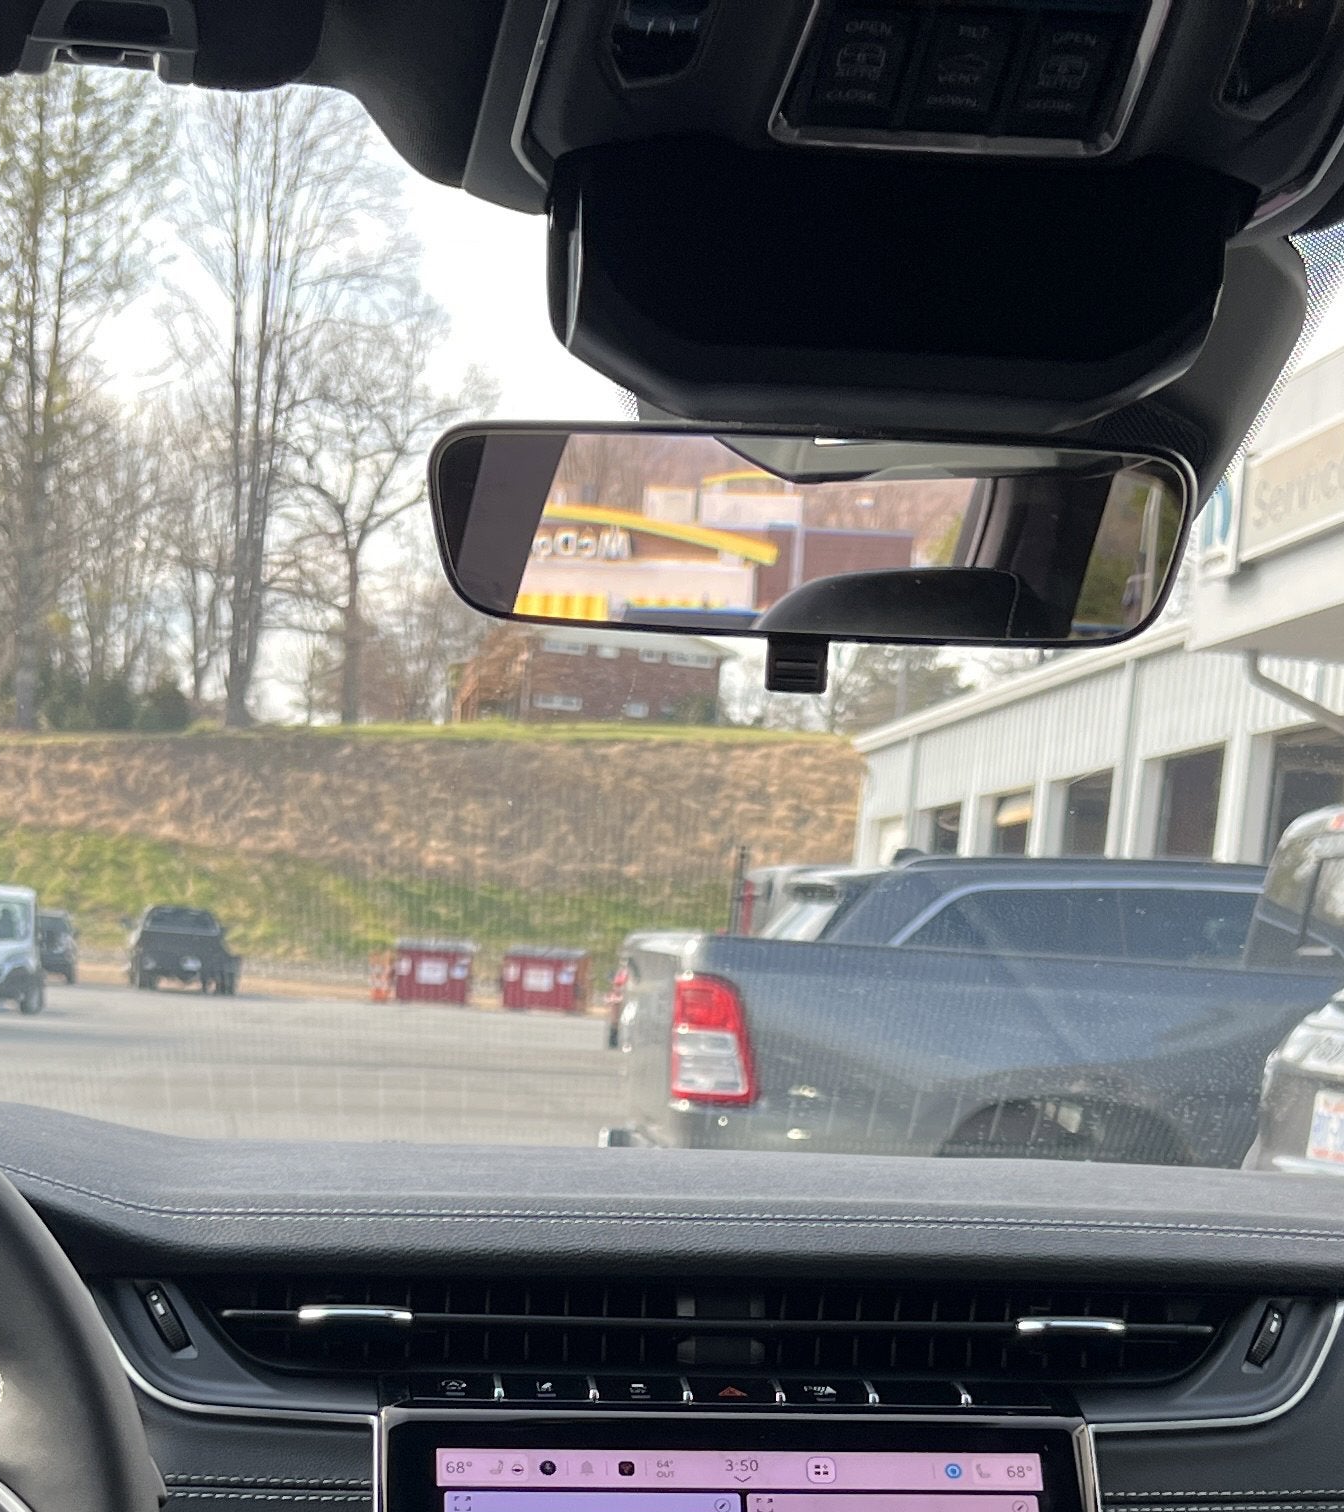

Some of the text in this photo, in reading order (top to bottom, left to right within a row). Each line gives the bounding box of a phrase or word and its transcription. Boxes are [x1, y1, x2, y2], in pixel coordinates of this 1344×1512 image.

[445, 1461, 473, 1474] 68°
[656, 1459, 674, 1468] 64°
[725, 1460, 759, 1472] 3:50
[656, 1470, 675, 1478] OUT
[1006, 1466, 1033, 1478] 68°
